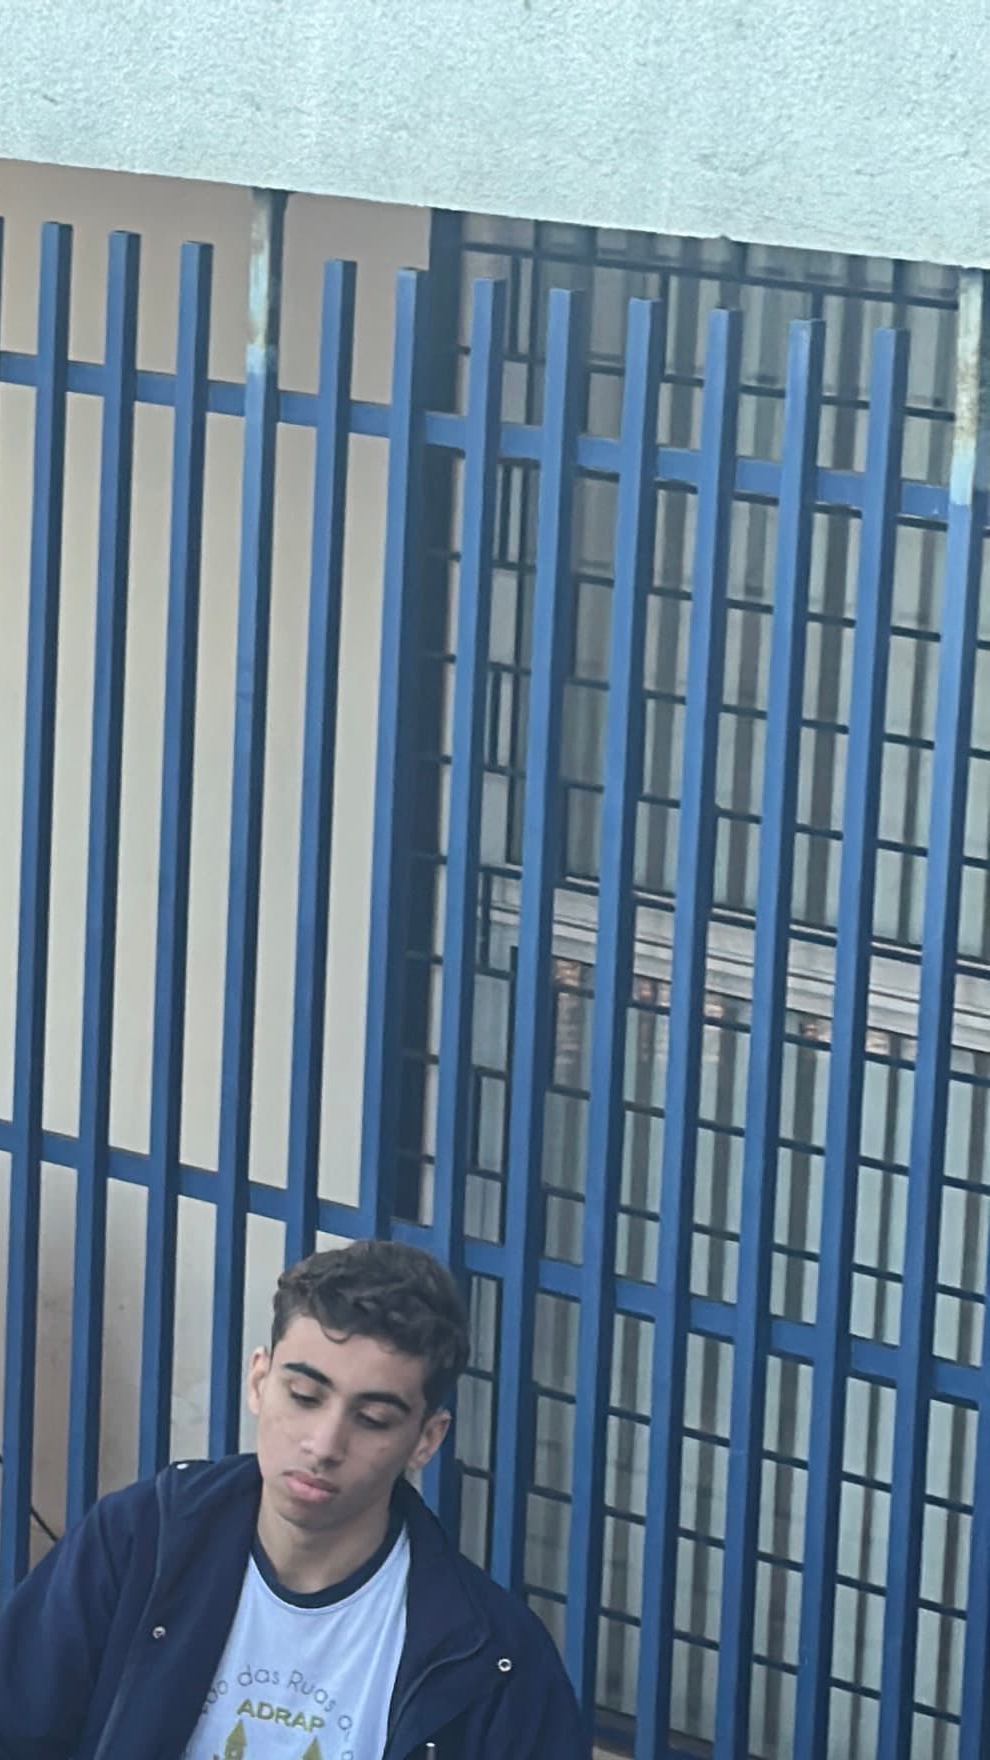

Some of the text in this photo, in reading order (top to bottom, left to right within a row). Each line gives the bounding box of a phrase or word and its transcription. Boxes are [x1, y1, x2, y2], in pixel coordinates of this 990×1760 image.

[237, 1664, 280, 1687] das
[286, 1669, 336, 1713] Ruas
[236, 1699, 325, 1733] ADRAP
